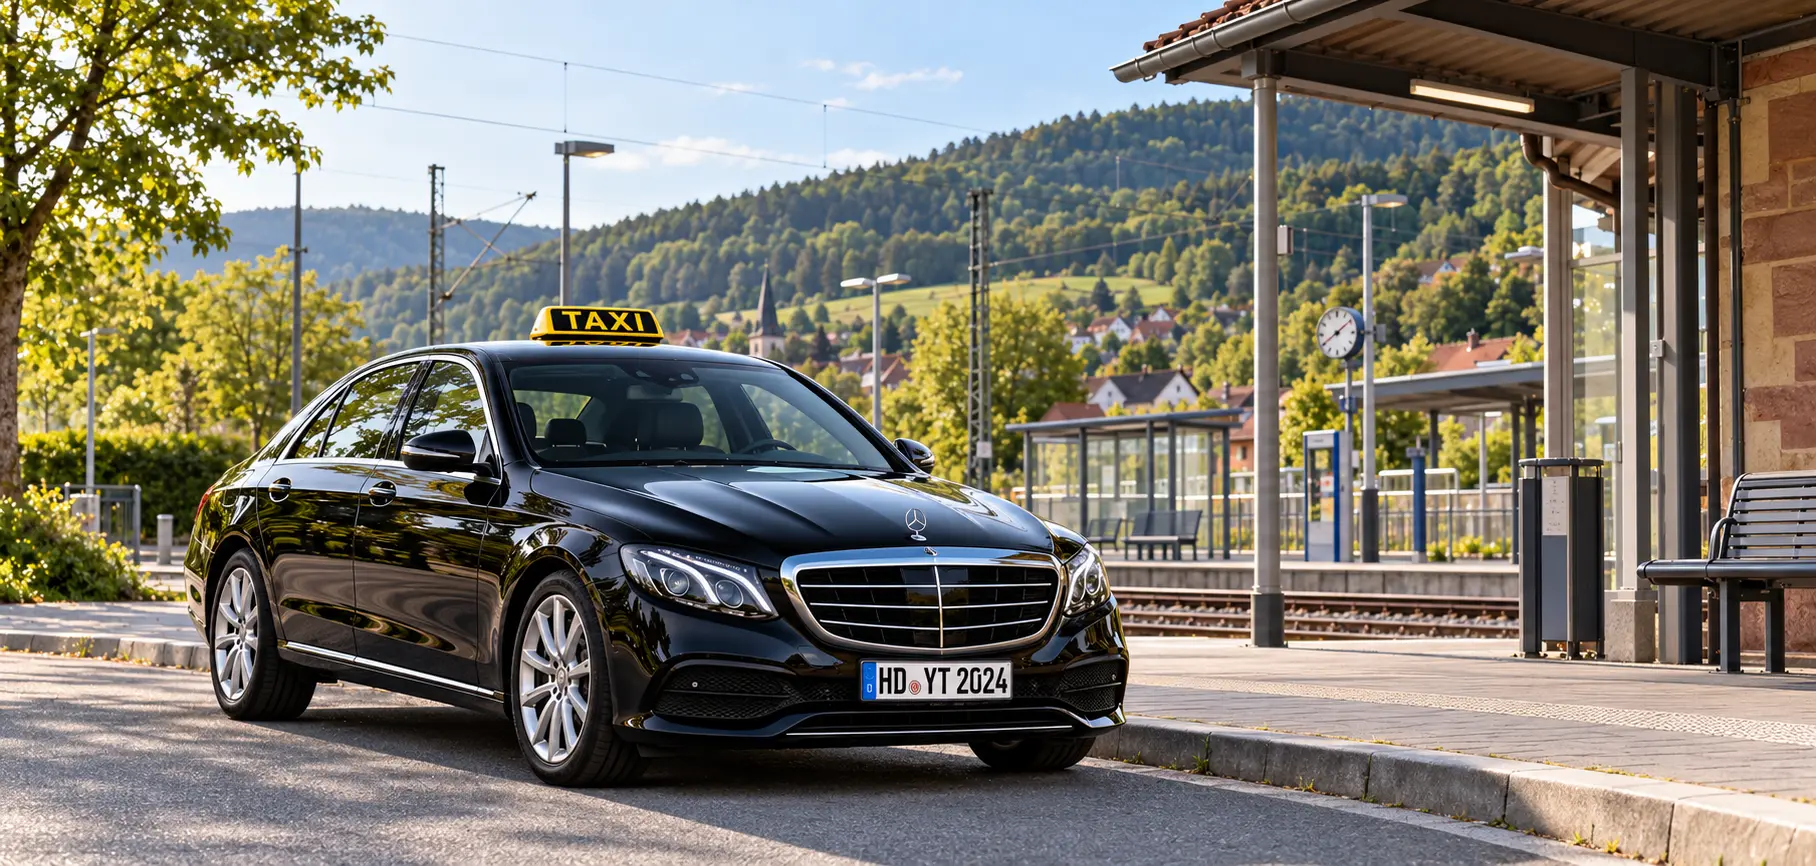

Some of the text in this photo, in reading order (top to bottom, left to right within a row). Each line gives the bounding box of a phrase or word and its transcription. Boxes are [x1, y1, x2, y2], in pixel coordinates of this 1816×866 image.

[561, 311, 645, 332] TAXI
[879, 667, 1008, 694] HD YT 2024
